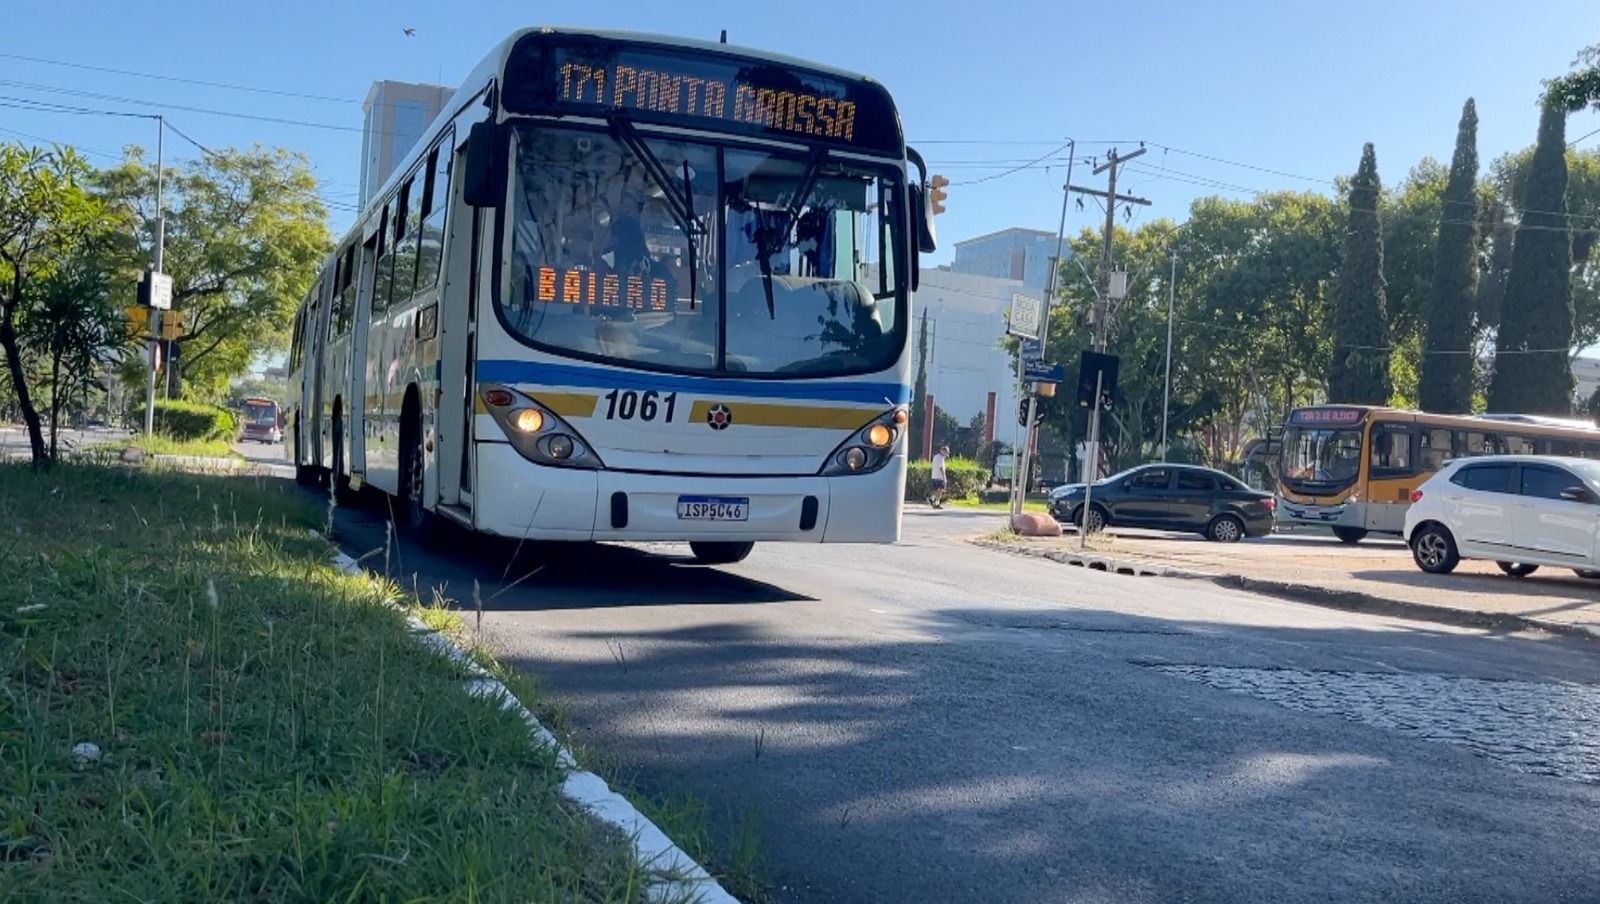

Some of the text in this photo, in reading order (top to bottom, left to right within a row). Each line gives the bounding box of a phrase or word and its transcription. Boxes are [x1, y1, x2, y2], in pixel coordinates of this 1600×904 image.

[560, 63, 857, 142] 171 PONTA GROSSA
[538, 266, 667, 310] BAIRRO
[605, 389, 677, 423] 1061
[685, 503, 741, 518] ISP5C46
